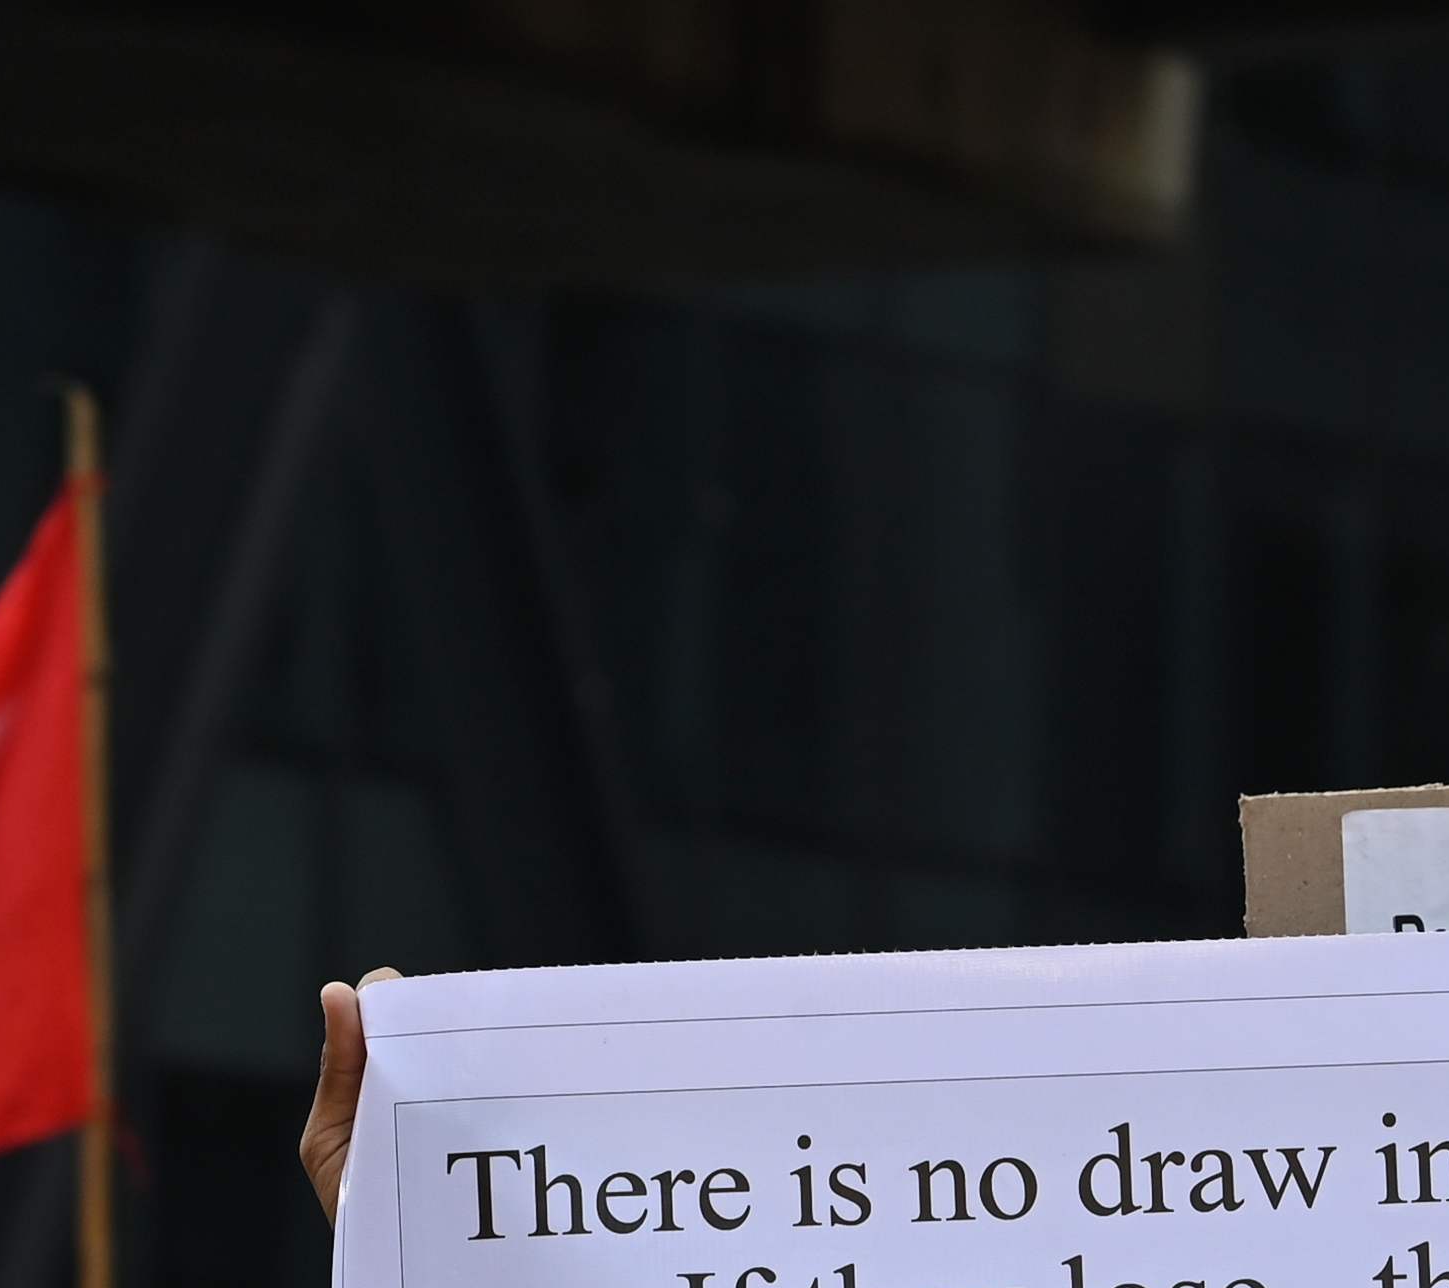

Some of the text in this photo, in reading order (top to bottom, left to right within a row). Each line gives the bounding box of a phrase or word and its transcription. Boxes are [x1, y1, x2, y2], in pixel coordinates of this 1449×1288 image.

[447, 1145, 750, 1240] There
[790, 1135, 871, 1226] is
[909, 1158, 1037, 1222] no
[1079, 1123, 1337, 1216] draw
